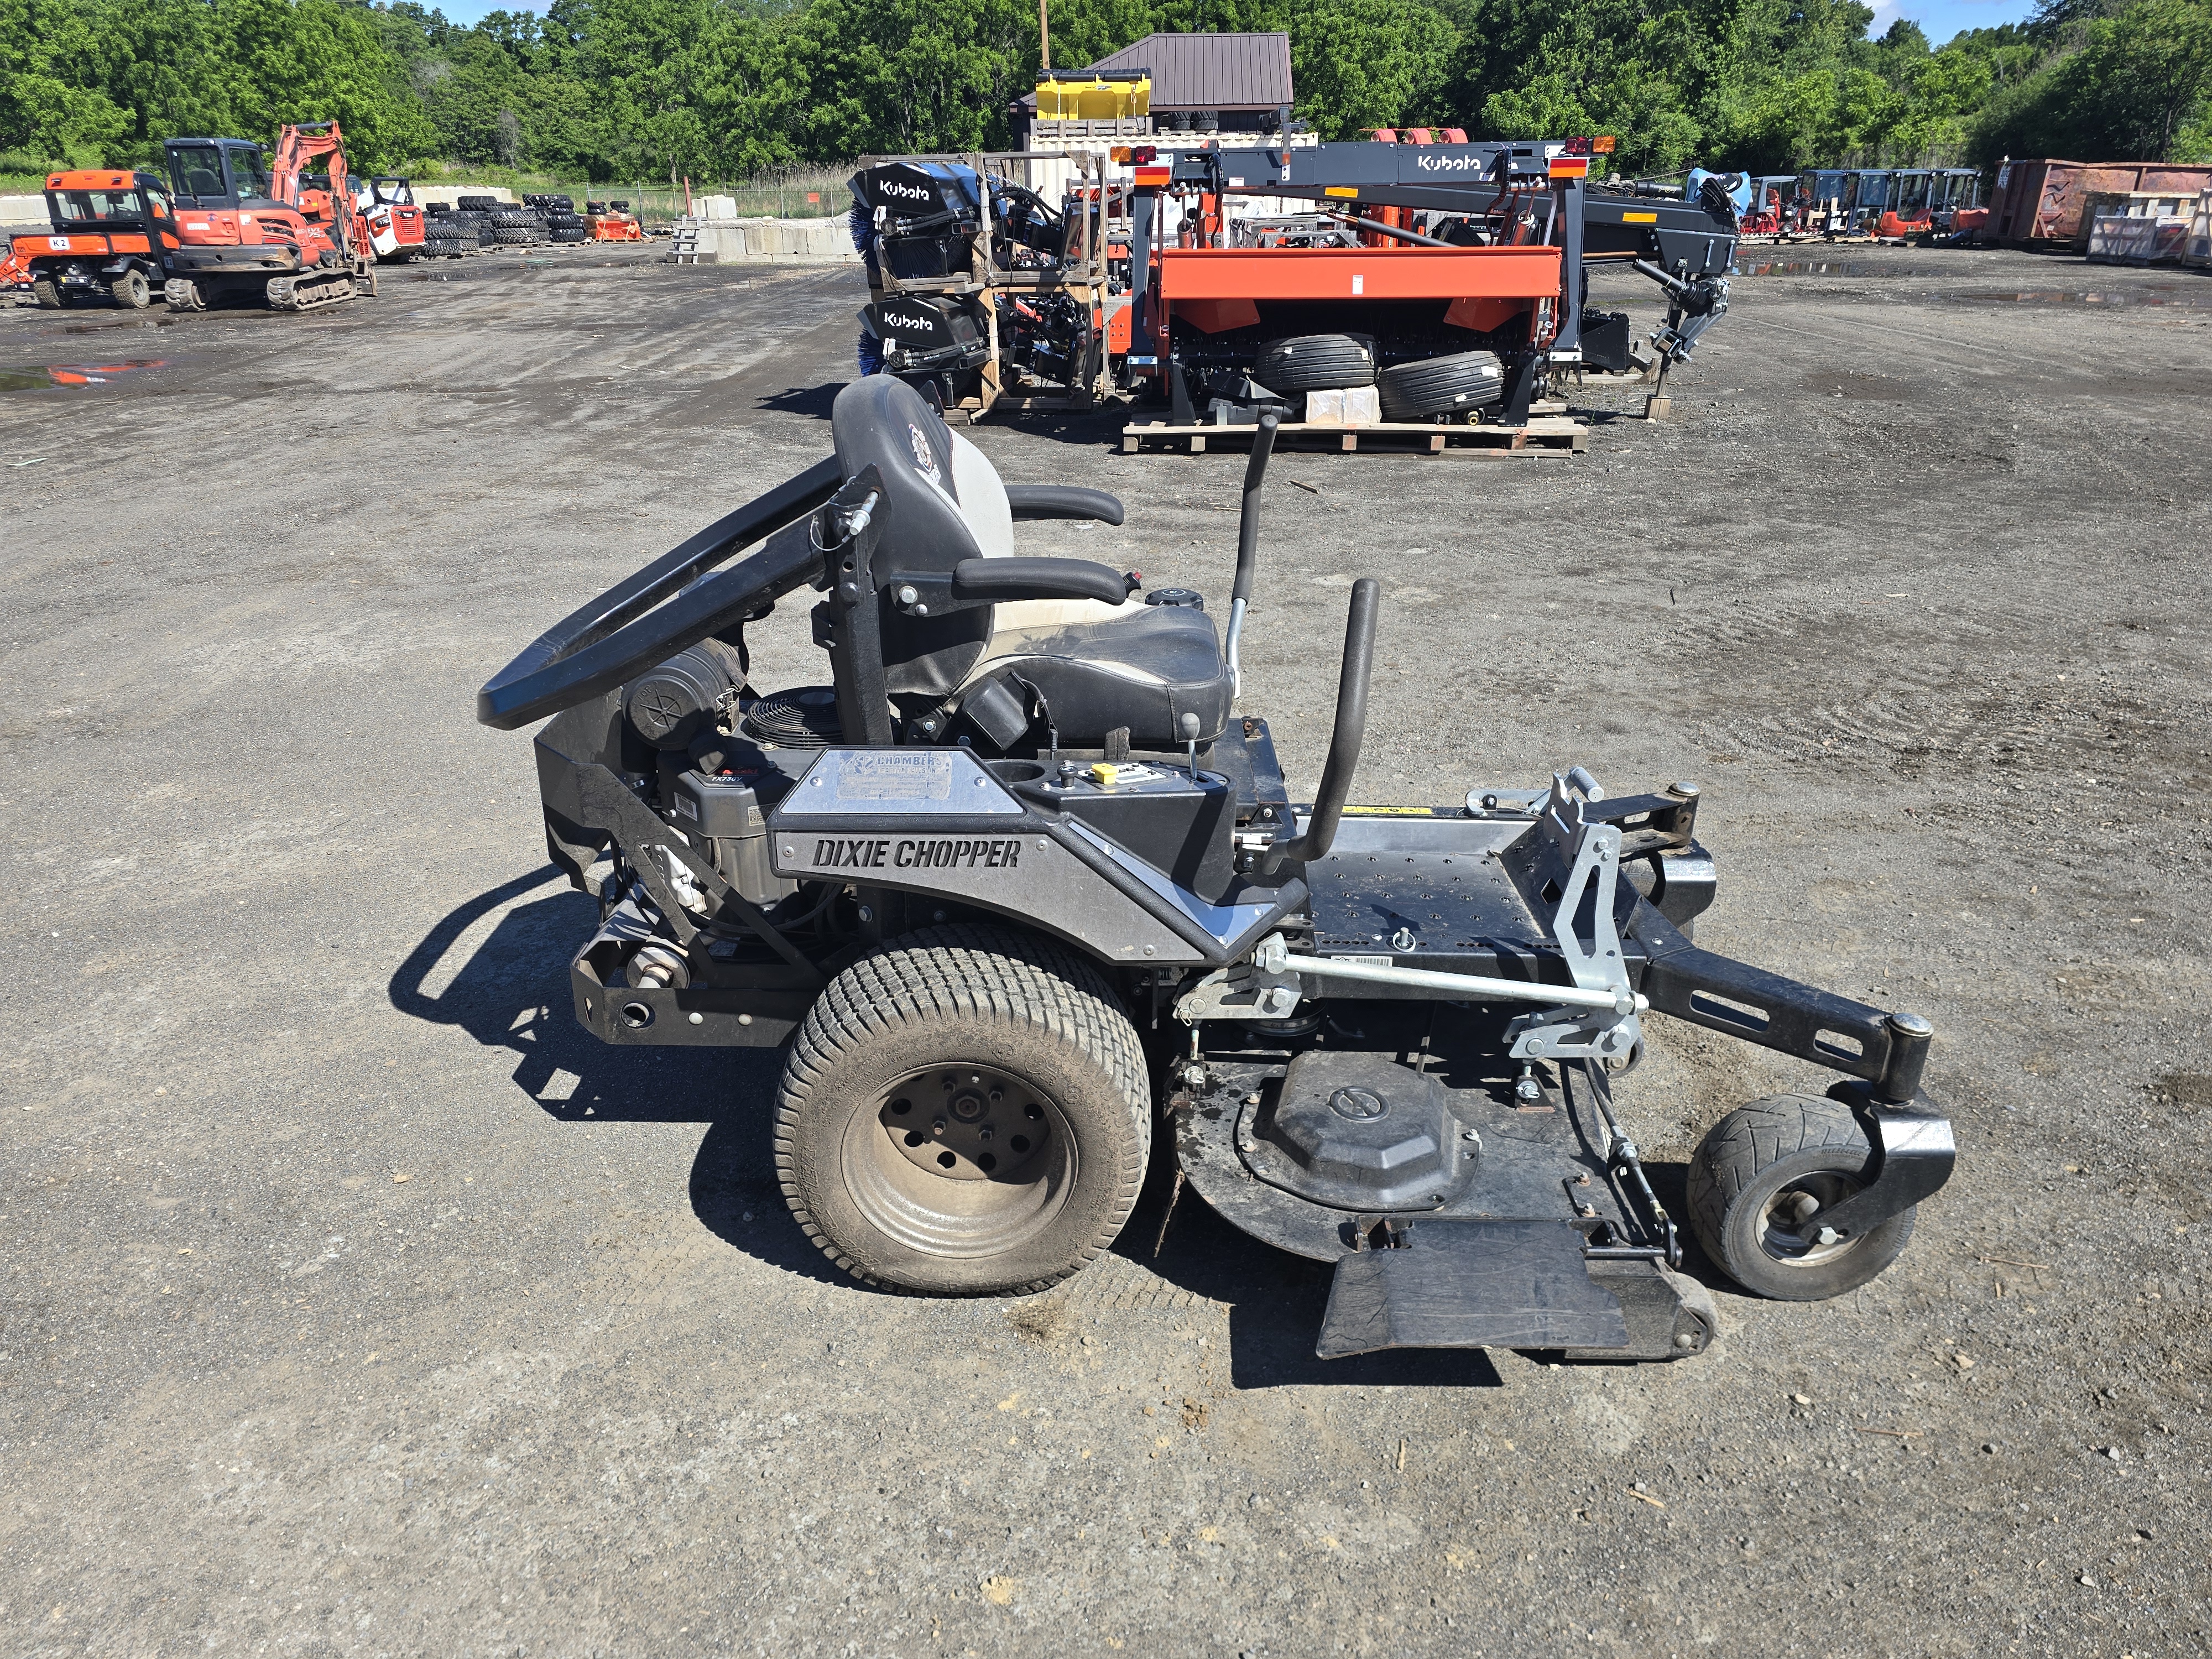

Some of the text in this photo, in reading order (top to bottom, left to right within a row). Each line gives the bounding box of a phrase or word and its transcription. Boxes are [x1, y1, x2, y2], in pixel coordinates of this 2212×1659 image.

[1418, 155, 1481, 171] Kubota
[880, 180, 929, 201] Kubota
[884, 312, 933, 331] Kubota
[812, 839, 1021, 868] DIXIE CHOPPER
